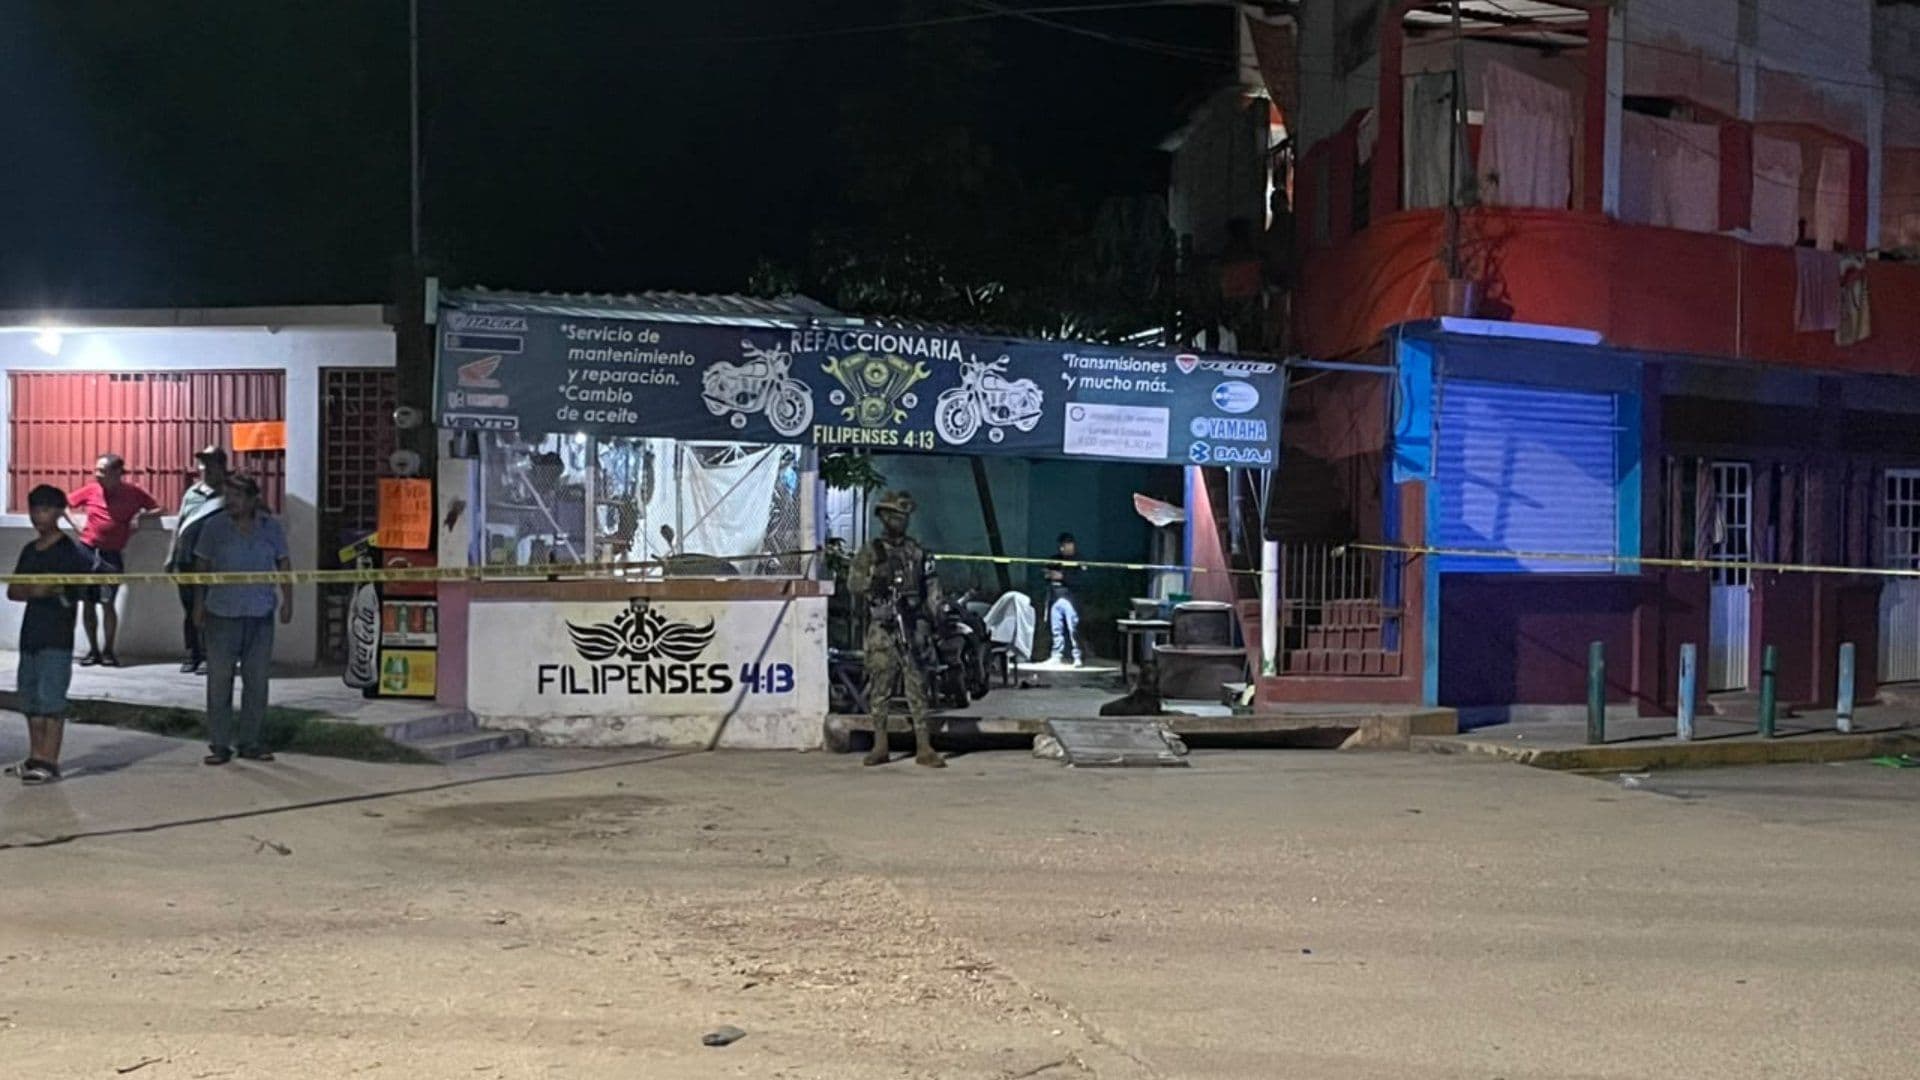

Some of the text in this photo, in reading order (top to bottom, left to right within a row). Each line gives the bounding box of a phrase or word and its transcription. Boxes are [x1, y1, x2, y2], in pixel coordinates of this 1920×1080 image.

[638, 325, 660, 343] de
[791, 330, 963, 362] REFACCIONARIA
[568, 347, 695, 366] mantenimiento
[568, 368, 680, 386] y reparación.
[1080, 374, 1131, 391] mucho
[556, 406, 638, 424] de aceite
[813, 425, 934, 449] FILIPENSES 4:13
[1208, 418, 1266, 441] YAMAHA
[1214, 446, 1271, 462] BAJAJ
[538, 663, 794, 694] FILIPENSES 4:13
